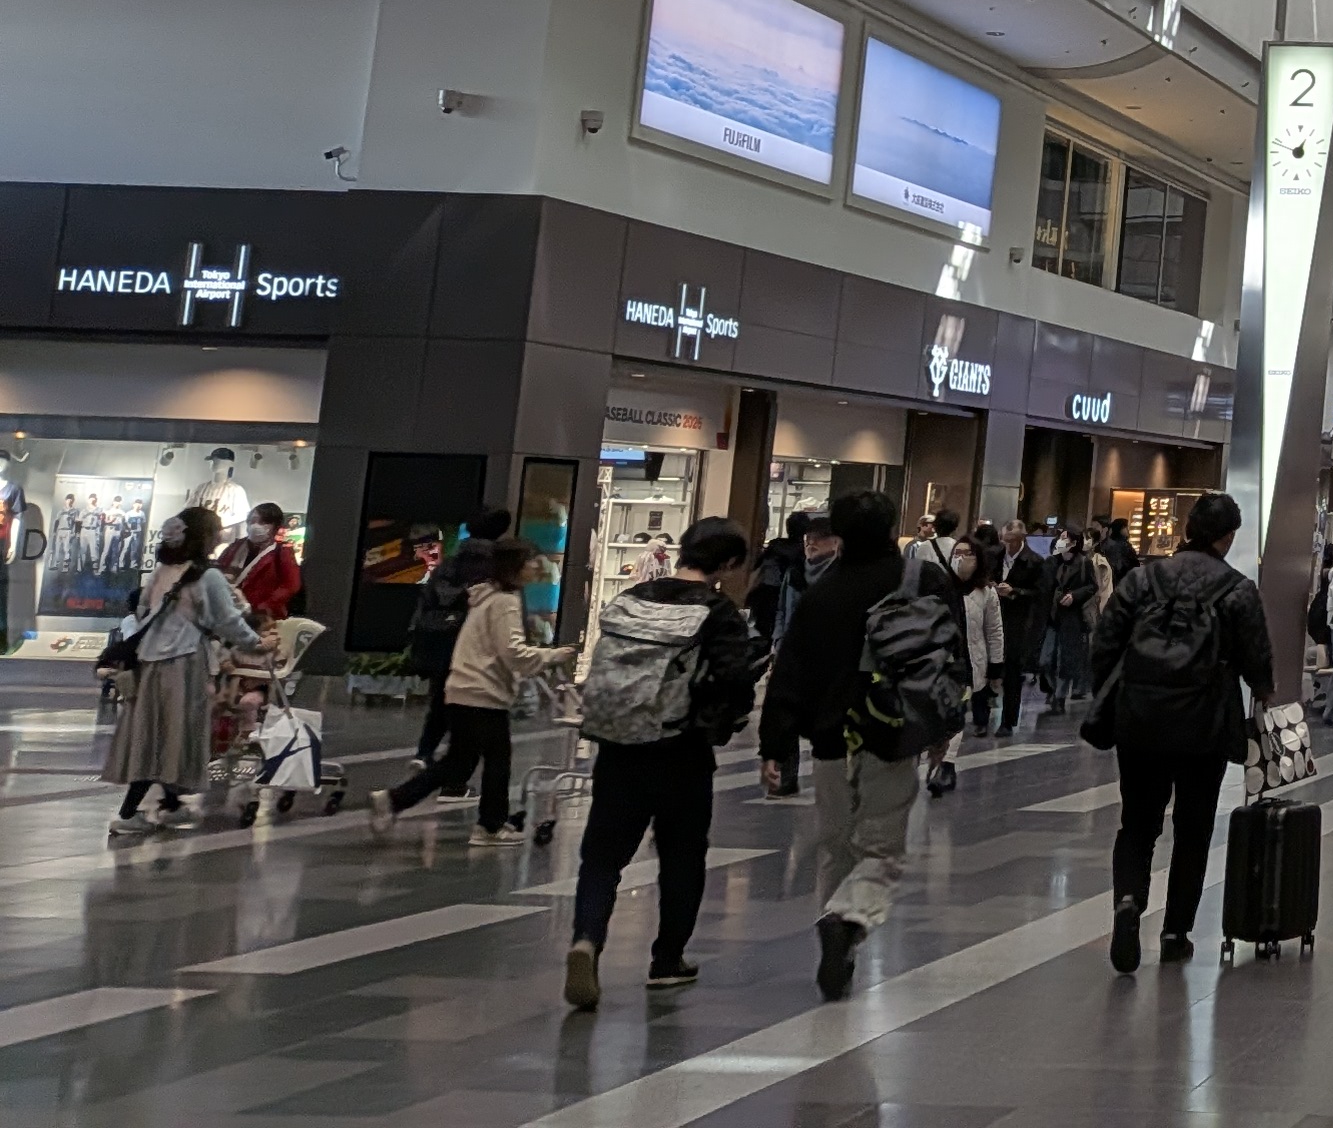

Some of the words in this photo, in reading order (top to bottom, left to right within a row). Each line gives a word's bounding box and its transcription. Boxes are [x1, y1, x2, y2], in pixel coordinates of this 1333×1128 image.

[1289, 69, 1316, 107] 2
[723, 127, 761, 153] FUJIFILM
[1279, 187, 1311, 195] SEIKO
[57, 268, 171, 294] HANEDA
[256, 273, 339, 300] Sports
[625, 299, 674, 328] HANEDA
[706, 313, 739, 339] Sports
[949, 358, 991, 395] GIANTS
[645, 410, 682, 428] CLASSIC
[1072, 393, 1111, 423] cuud
